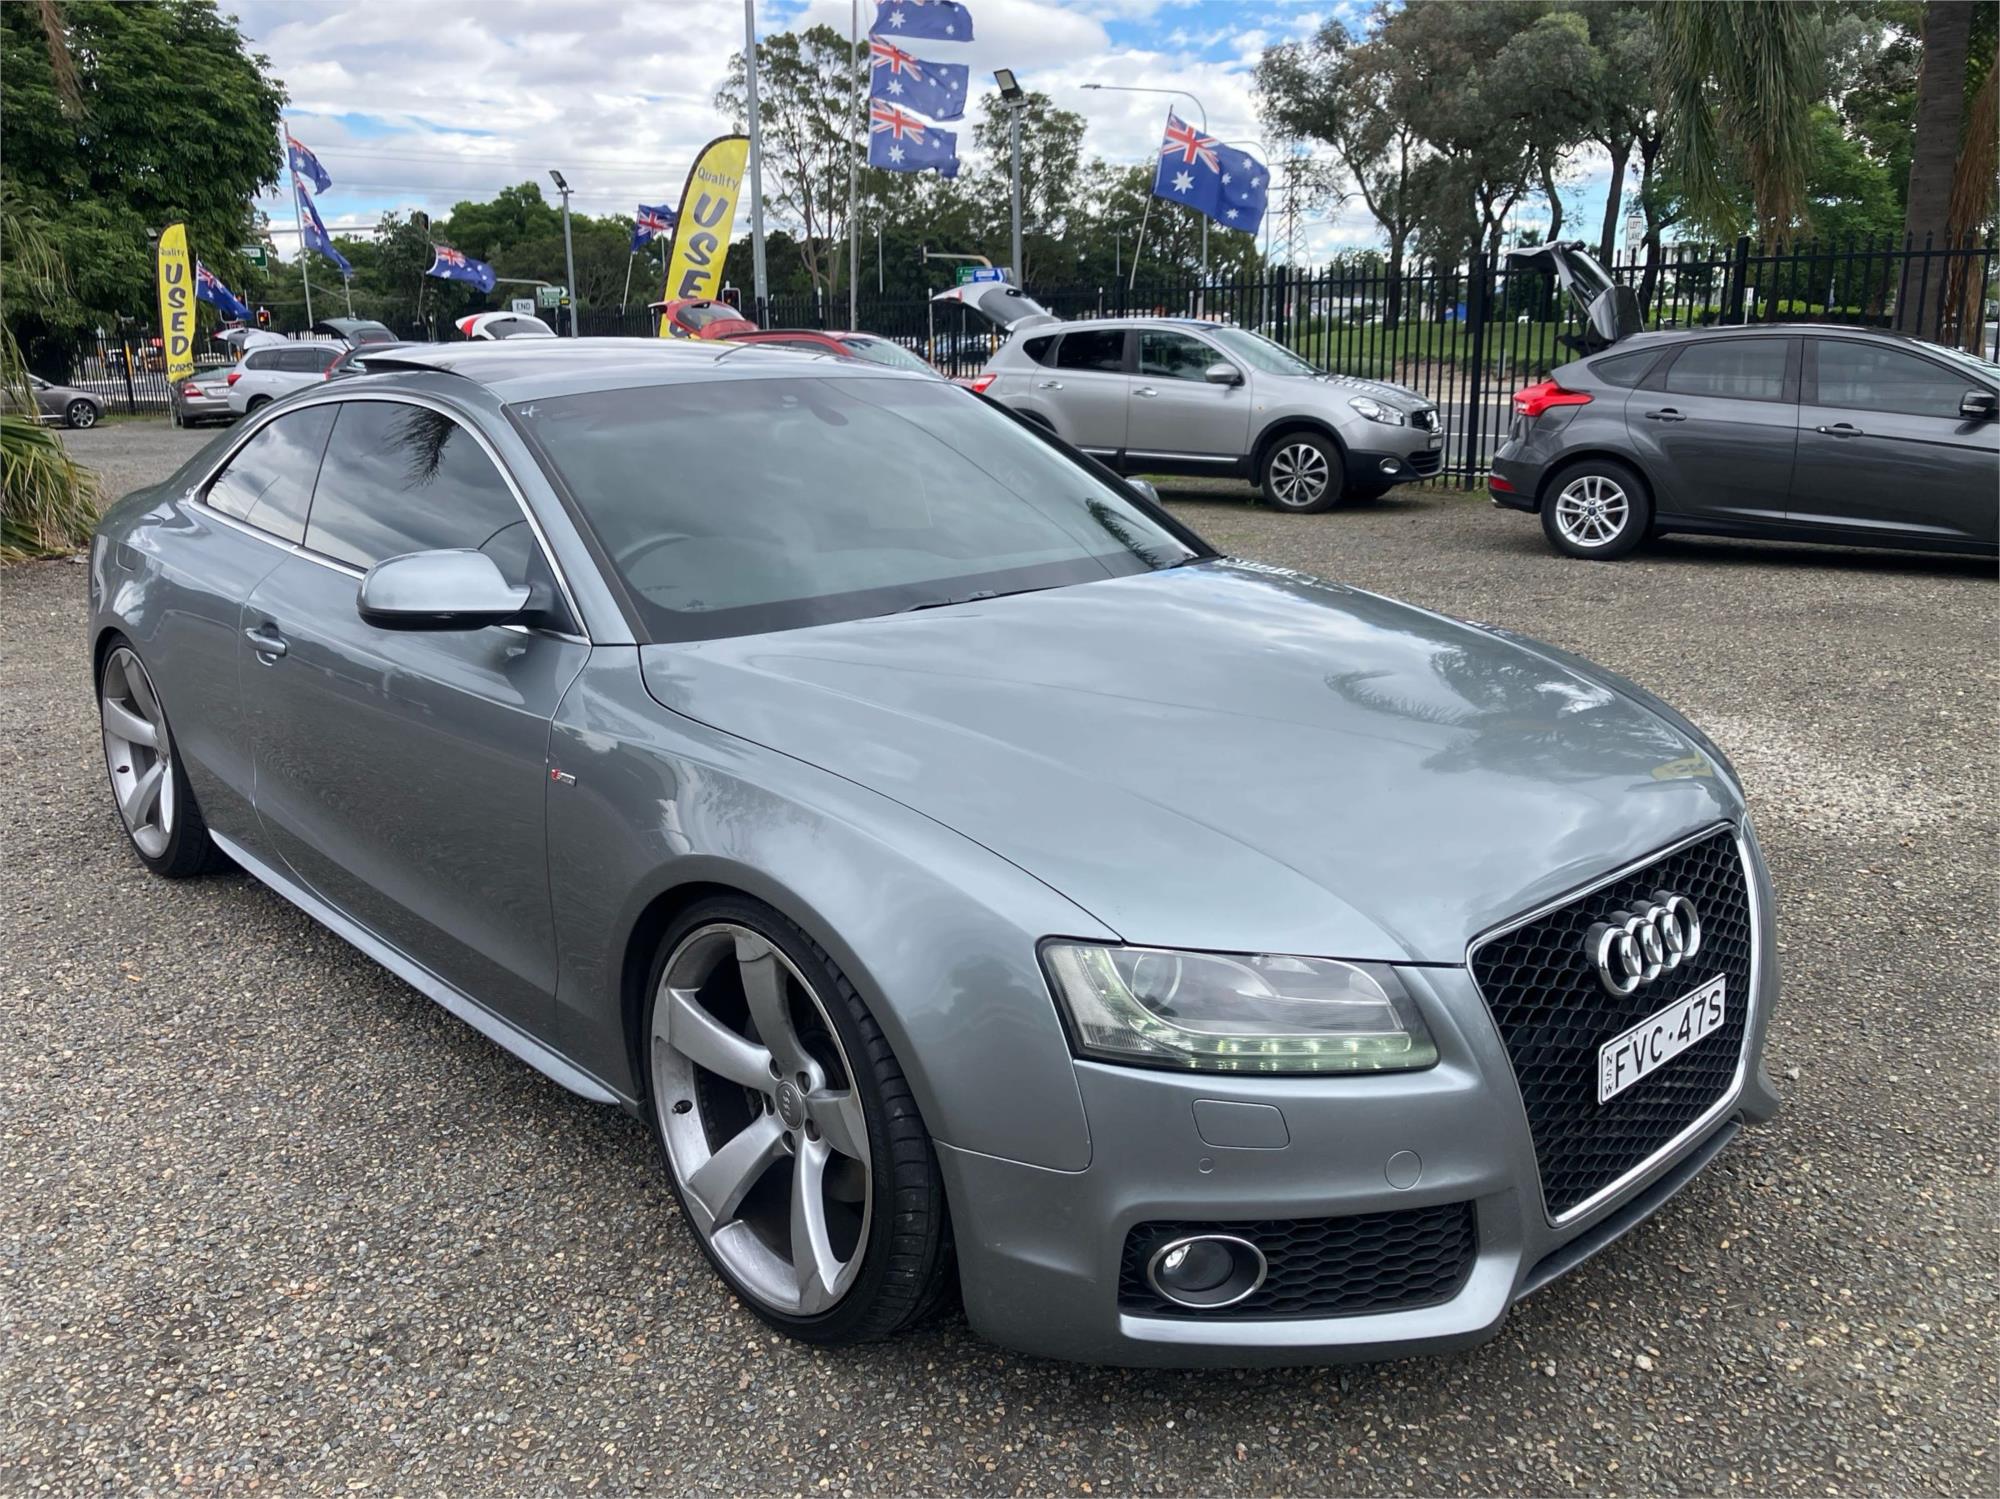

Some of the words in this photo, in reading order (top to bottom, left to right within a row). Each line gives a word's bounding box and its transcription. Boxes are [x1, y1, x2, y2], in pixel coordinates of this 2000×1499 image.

[698, 167, 739, 191] Quality
[669, 193, 728, 338] USE
[165, 263, 189, 356] USED
[516, 302, 531, 311] END
[1604, 1053, 1615, 1095] NSW
